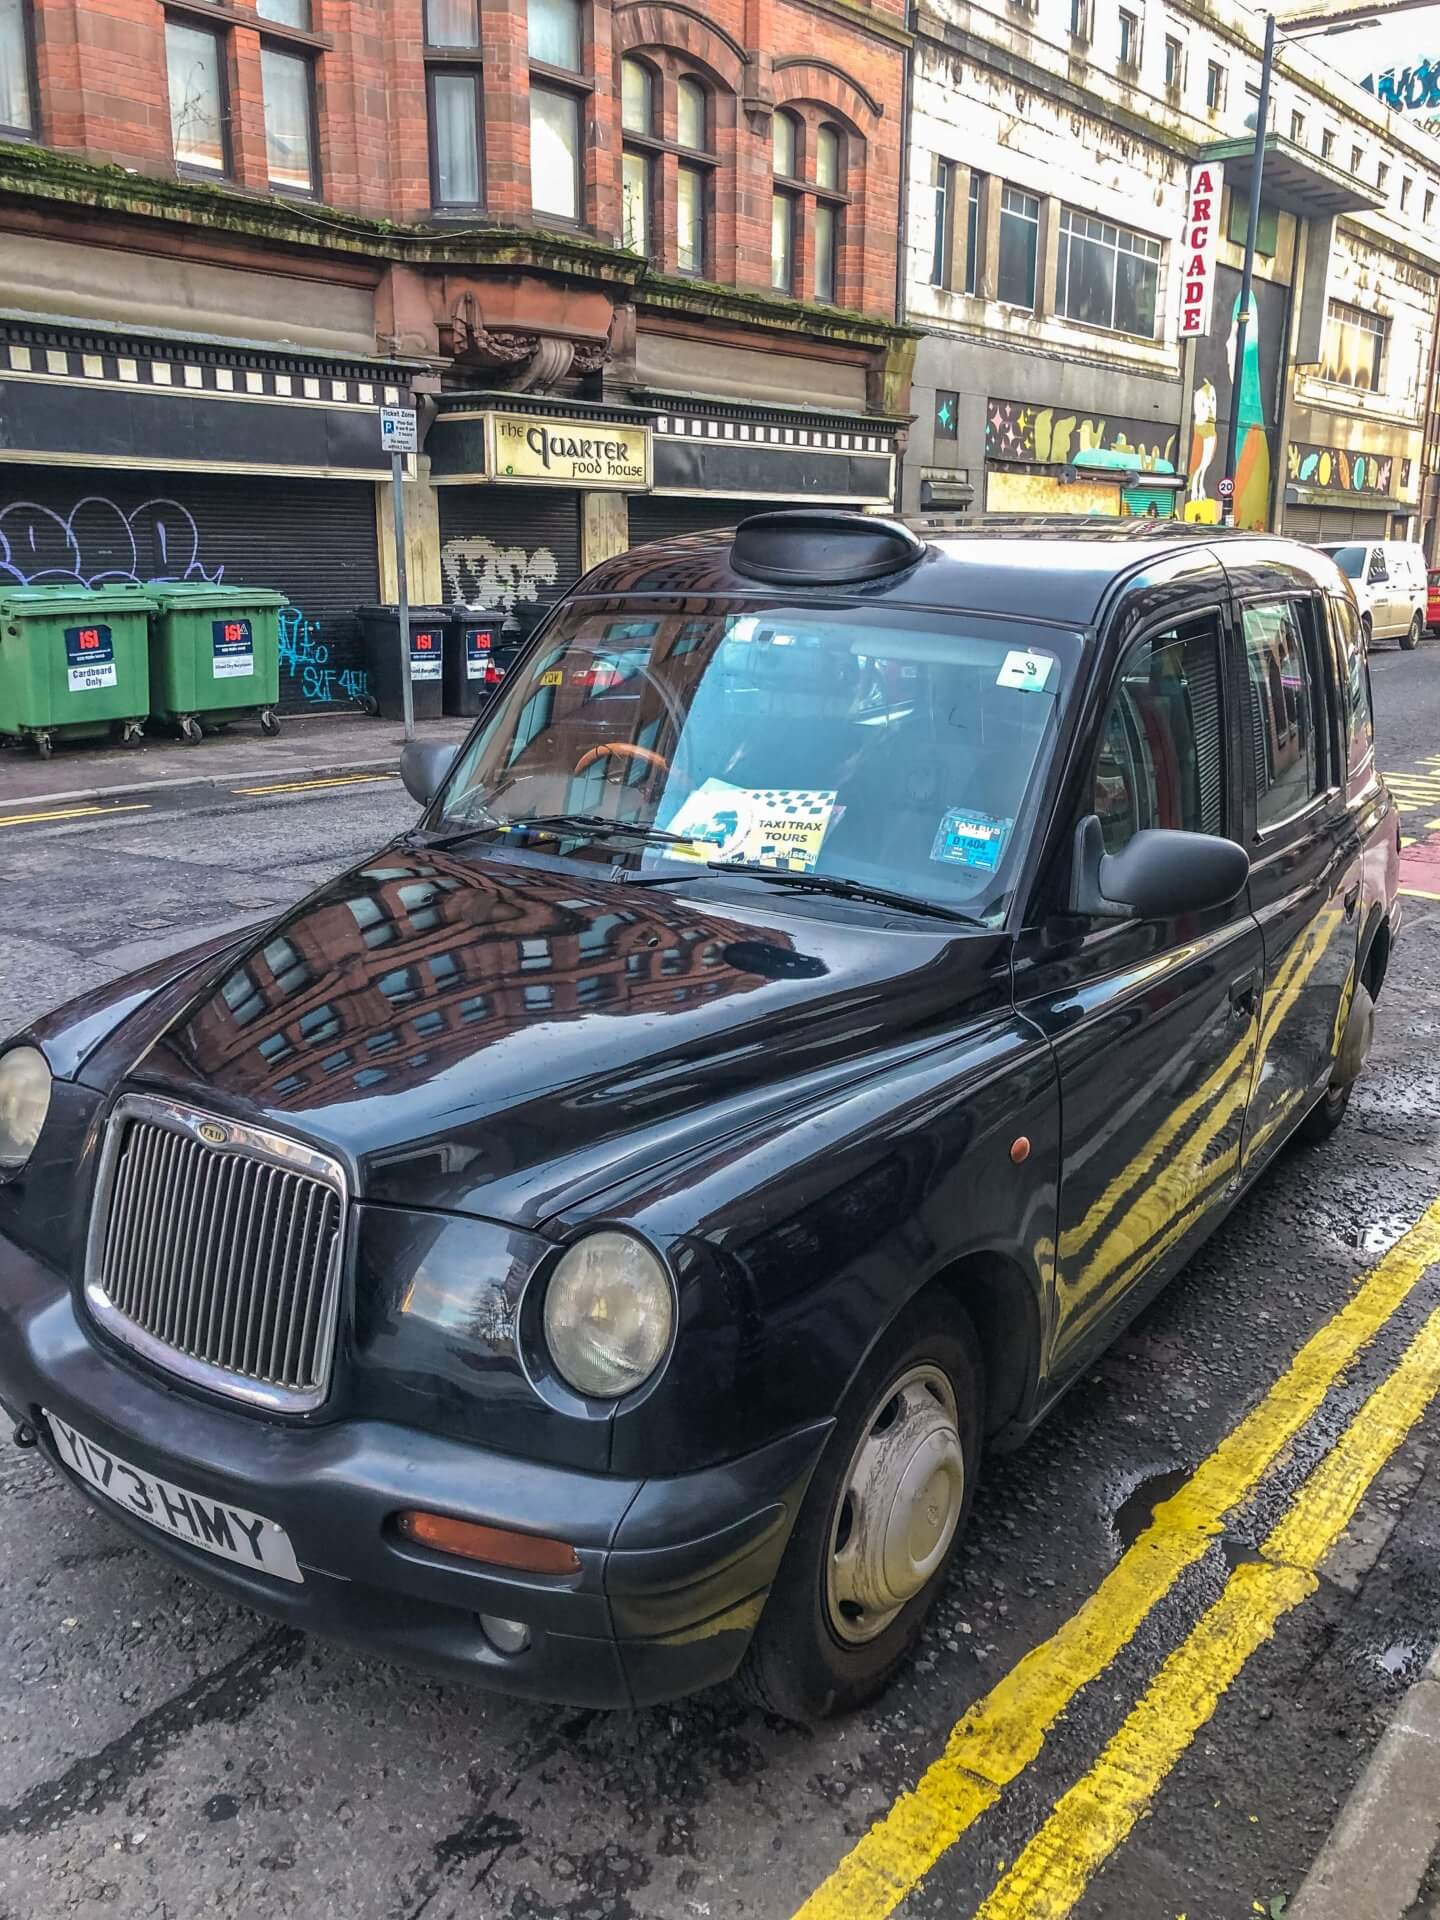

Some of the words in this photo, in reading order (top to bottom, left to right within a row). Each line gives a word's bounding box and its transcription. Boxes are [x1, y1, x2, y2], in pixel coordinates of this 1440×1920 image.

[1183, 171, 1214, 331] ARCADE
[383, 409, 400, 417] Ticket
[1220, 483, 1233, 491] 20
[73, 666, 112, 679] Cardboard
[86, 677, 102, 687] Only
[759, 819, 786, 830] TAXI
[788, 820, 823, 832] TRAX
[765, 832, 808, 843] TOURS
[55, 1418, 154, 1515] Y173
[156, 1483, 265, 1562] HMY
